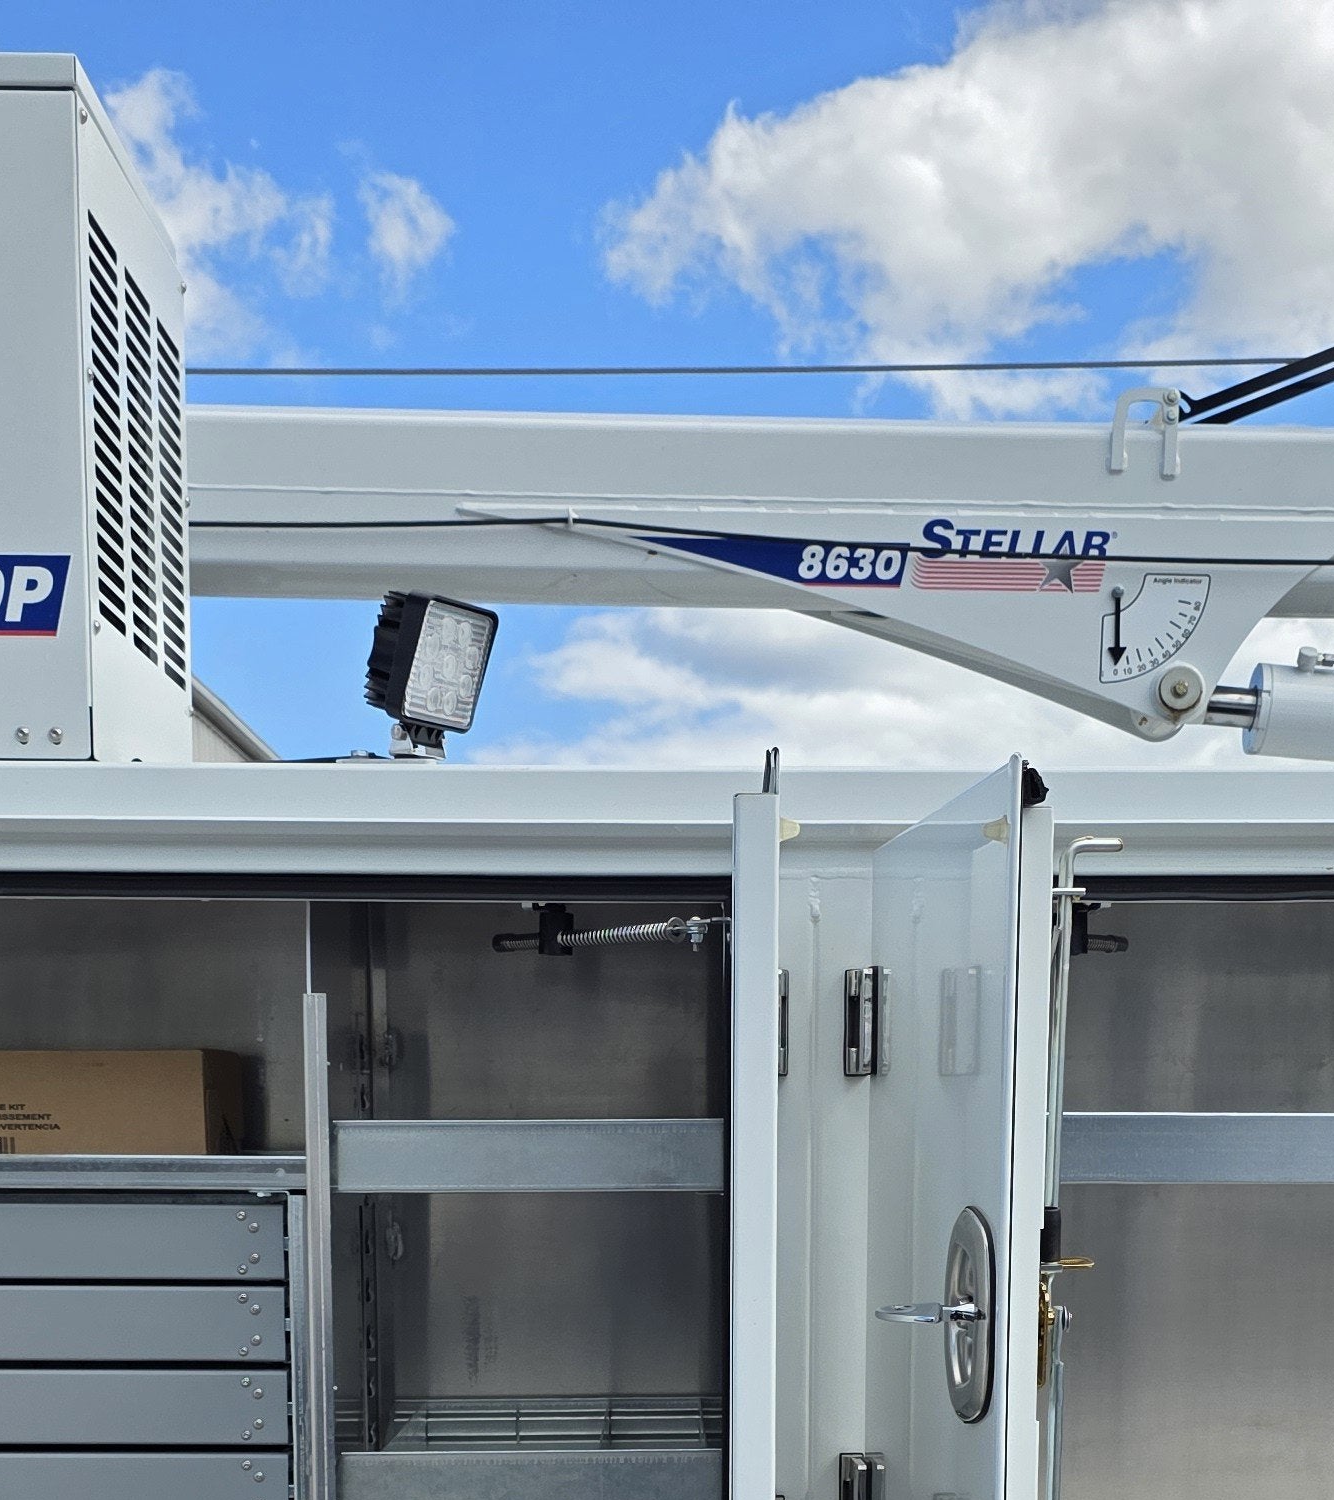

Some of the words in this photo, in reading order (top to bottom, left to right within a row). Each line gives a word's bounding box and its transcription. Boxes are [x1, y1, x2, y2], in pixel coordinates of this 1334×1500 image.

[920, 518, 1111, 559] STELLAR
[798, 545, 902, 580] 8630
[1123, 667, 1133, 675] 10
[1137, 663, 1147, 673] 20
